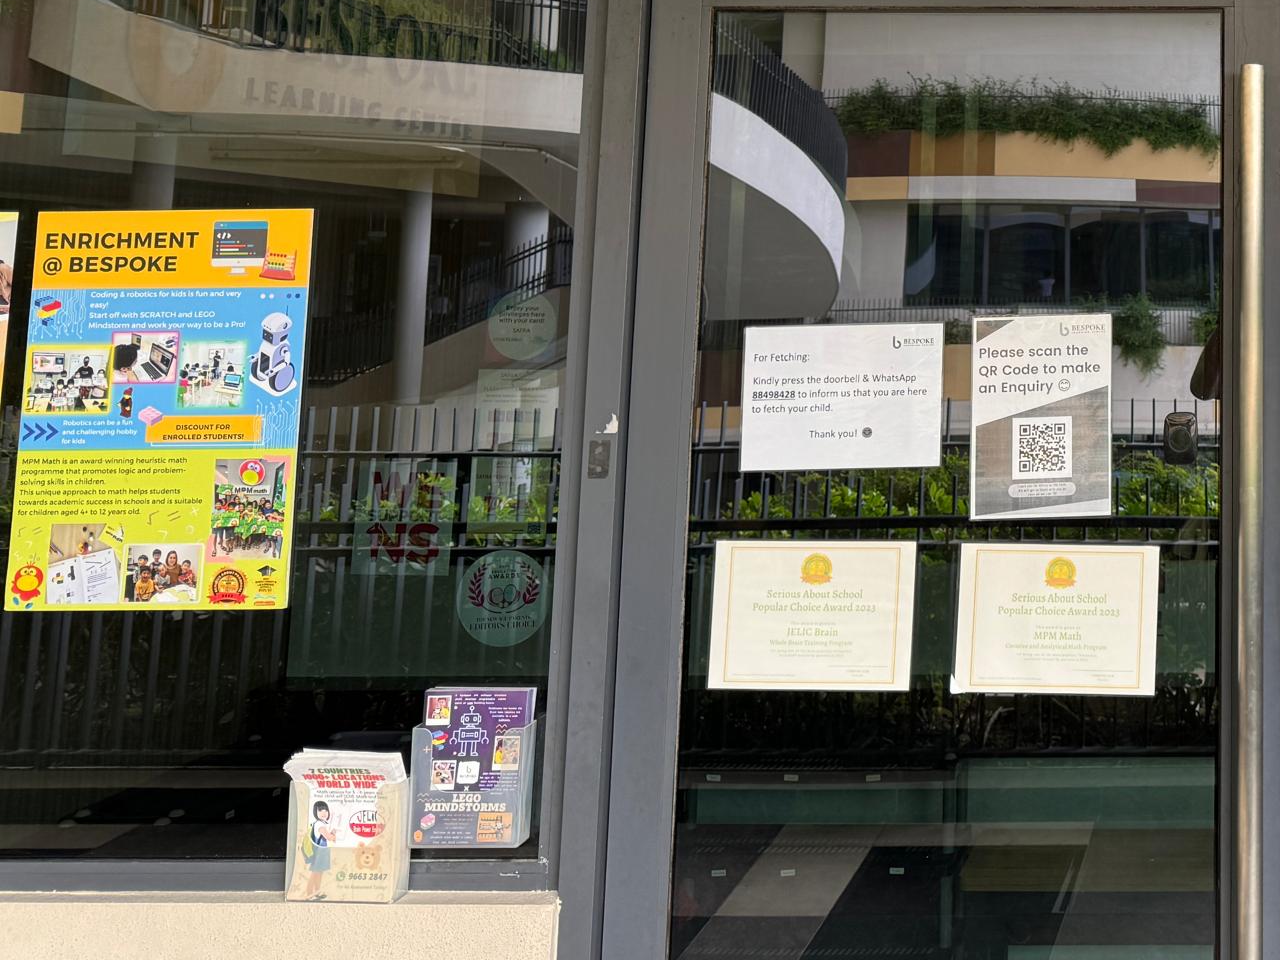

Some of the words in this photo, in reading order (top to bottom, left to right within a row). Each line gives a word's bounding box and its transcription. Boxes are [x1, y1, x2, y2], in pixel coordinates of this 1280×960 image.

[46, 232, 200, 250] ENRICHMENT
[43, 257, 62, 276] @
[70, 256, 178, 273] BESPOKE
[159, 290, 169, 298] for
[226, 290, 242, 298] very
[168, 322, 186, 330] your
[980, 347, 1024, 359] Please
[1028, 348, 1062, 357] scan
[1066, 344, 1089, 356] the
[754, 354, 768, 362] For
[770, 353, 810, 363] Fetching:
[979, 365, 998, 378] QR
[1002, 364, 1039, 376] Code
[1043, 364, 1057, 374] to
[1062, 362, 1101, 374] make
[753, 377, 779, 386] Kindly
[782, 378, 805, 387] press
[807, 376, 821, 384] the
[824, 374, 860, 384] doorbell
[862, 374, 869, 383] &
[872, 374, 917, 383] WhatsApp
[979, 384, 996, 394] an
[1002, 380, 1054, 396] Enquiry
[752, 390, 796, 400] 88498428
[798, 390, 807, 399] to
[810, 390, 838, 398] inform
[840, 390, 851, 398] us
[854, 388, 871, 397] that
[873, 390, 889, 398] you
[891, 388, 905, 396] are
[908, 388, 928, 396] here
[764, 404, 785, 413] fetch
[788, 406, 808, 415] your
[810, 404, 833, 412] child.
[76, 428, 115, 436] challenging
[116, 428, 138, 436] hobby
[810, 430, 835, 438] Thank
[838, 430, 858, 439] you!
[82, 468, 117, 476] promotes
[20, 479, 46, 487] solving
[62, 488, 97, 497] approach
[128, 488, 148, 496] helps
[60, 509, 79, 517] aged
[108, 509, 127, 517] years
[767, 590, 801, 599] Serious
[802, 590, 830, 599] About
[832, 589, 863, 599] School
[1012, 593, 1046, 603] Serious
[1048, 594, 1075, 603] About
[1076, 594, 1108, 604] School
[753, 602, 788, 614] Popular
[790, 602, 821, 612] Choice
[822, 602, 853, 612] Award
[856, 604, 876, 613] 2023
[998, 606, 1033, 617] Popular
[1035, 606, 1066, 616] Choice
[1068, 606, 1097, 616] Award
[1100, 609, 1121, 618] 2023
[787, 627, 813, 637] JELIC
[814, 628, 839, 637] Brain
[1034, 632, 1057, 641] MPM
[1060, 632, 1082, 641] Math
[316, 780, 350, 789] WORLD
[352, 781, 378, 789] WIDE
[452, 794, 482, 803] LEGO
[424, 802, 507, 812] MINDSTORMS
[348, 872, 368, 881] 9663
[369, 872, 388, 881] 2847
